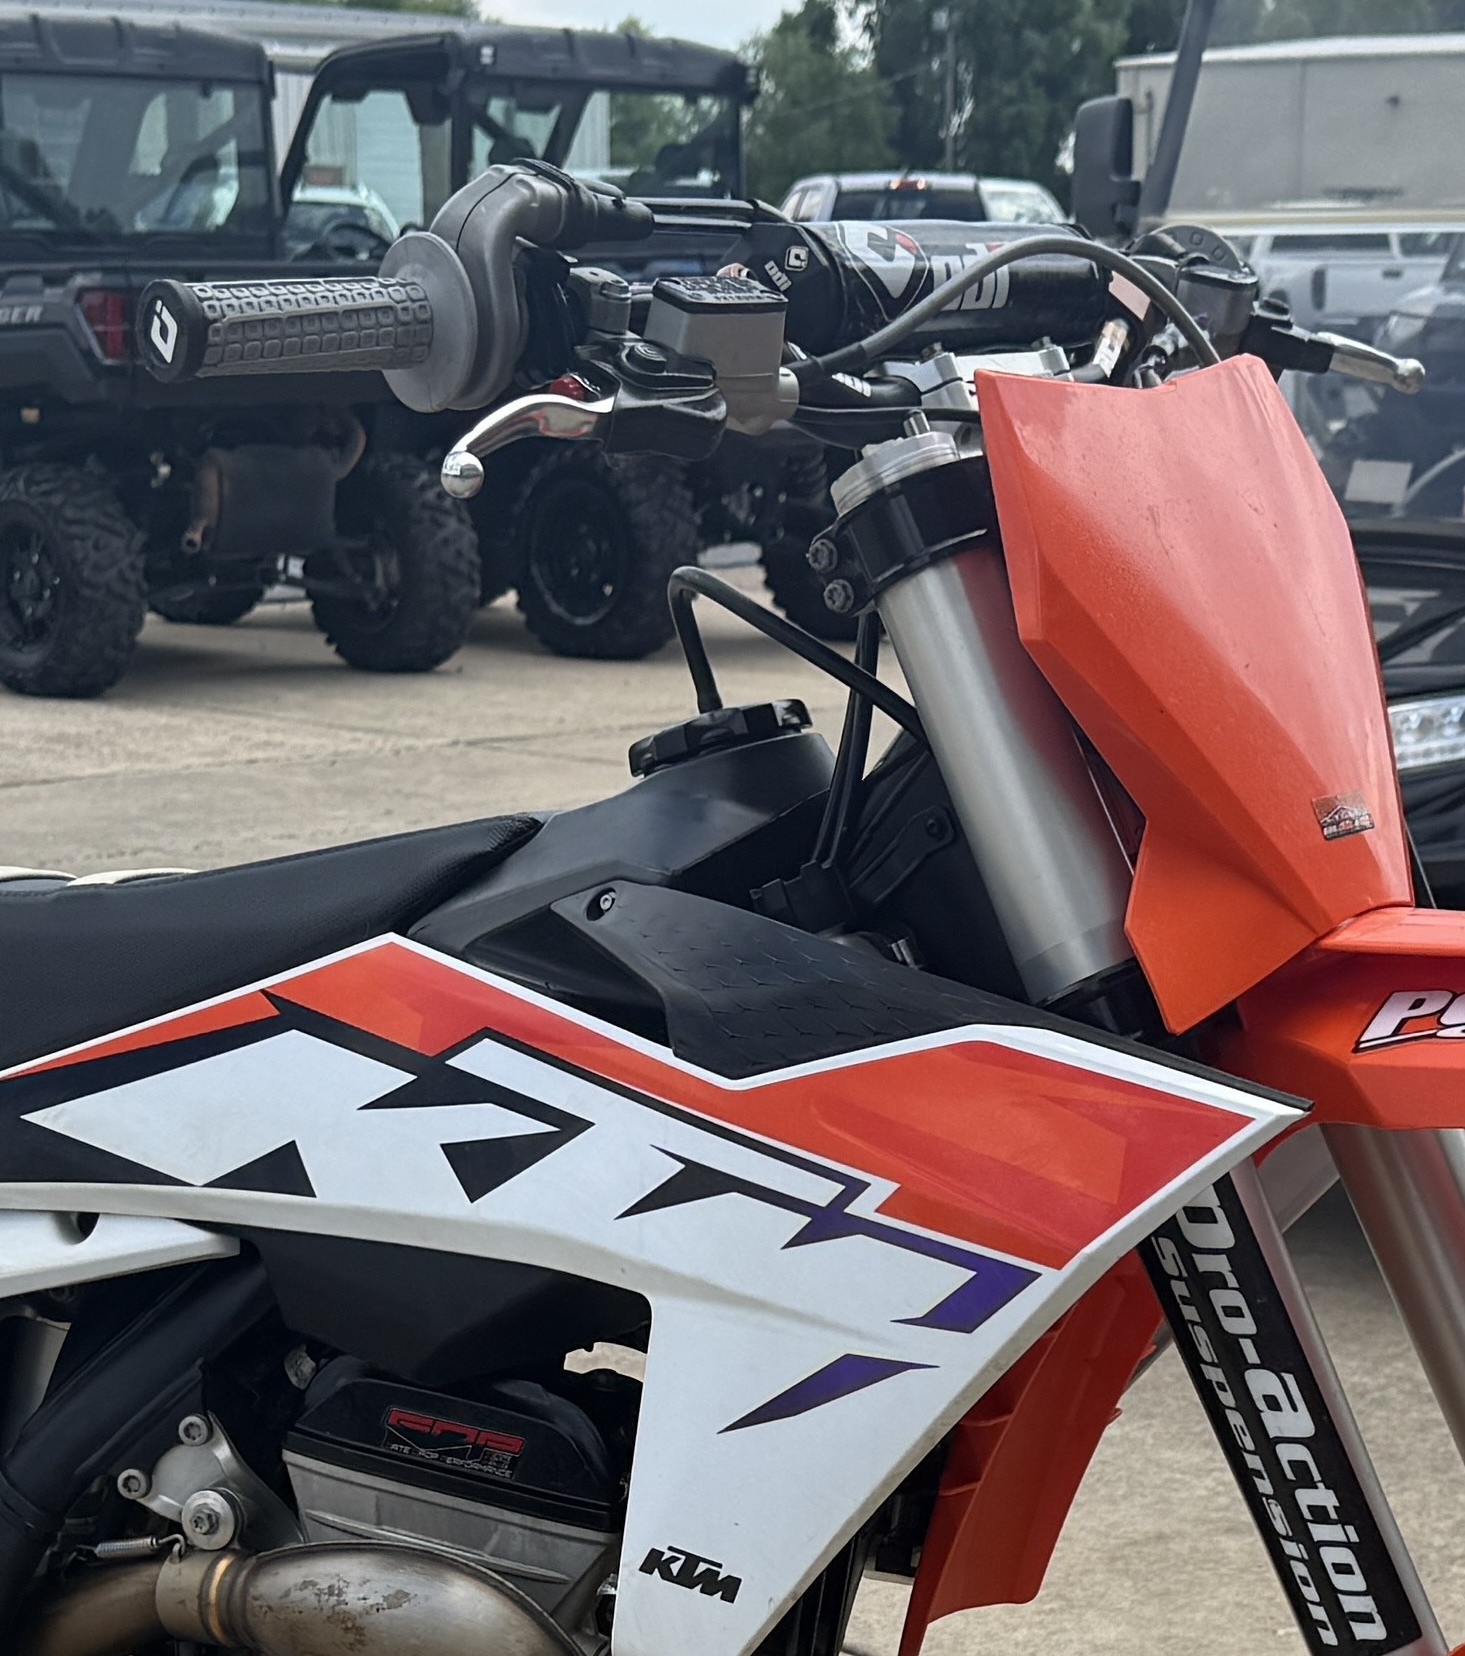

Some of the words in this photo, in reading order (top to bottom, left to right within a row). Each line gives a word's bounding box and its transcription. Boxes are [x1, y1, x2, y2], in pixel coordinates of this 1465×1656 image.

[638, 1545, 743, 1605] KTM
[1150, 1235, 1339, 1647] suspension
[1174, 1184, 1388, 1642] pro-action
